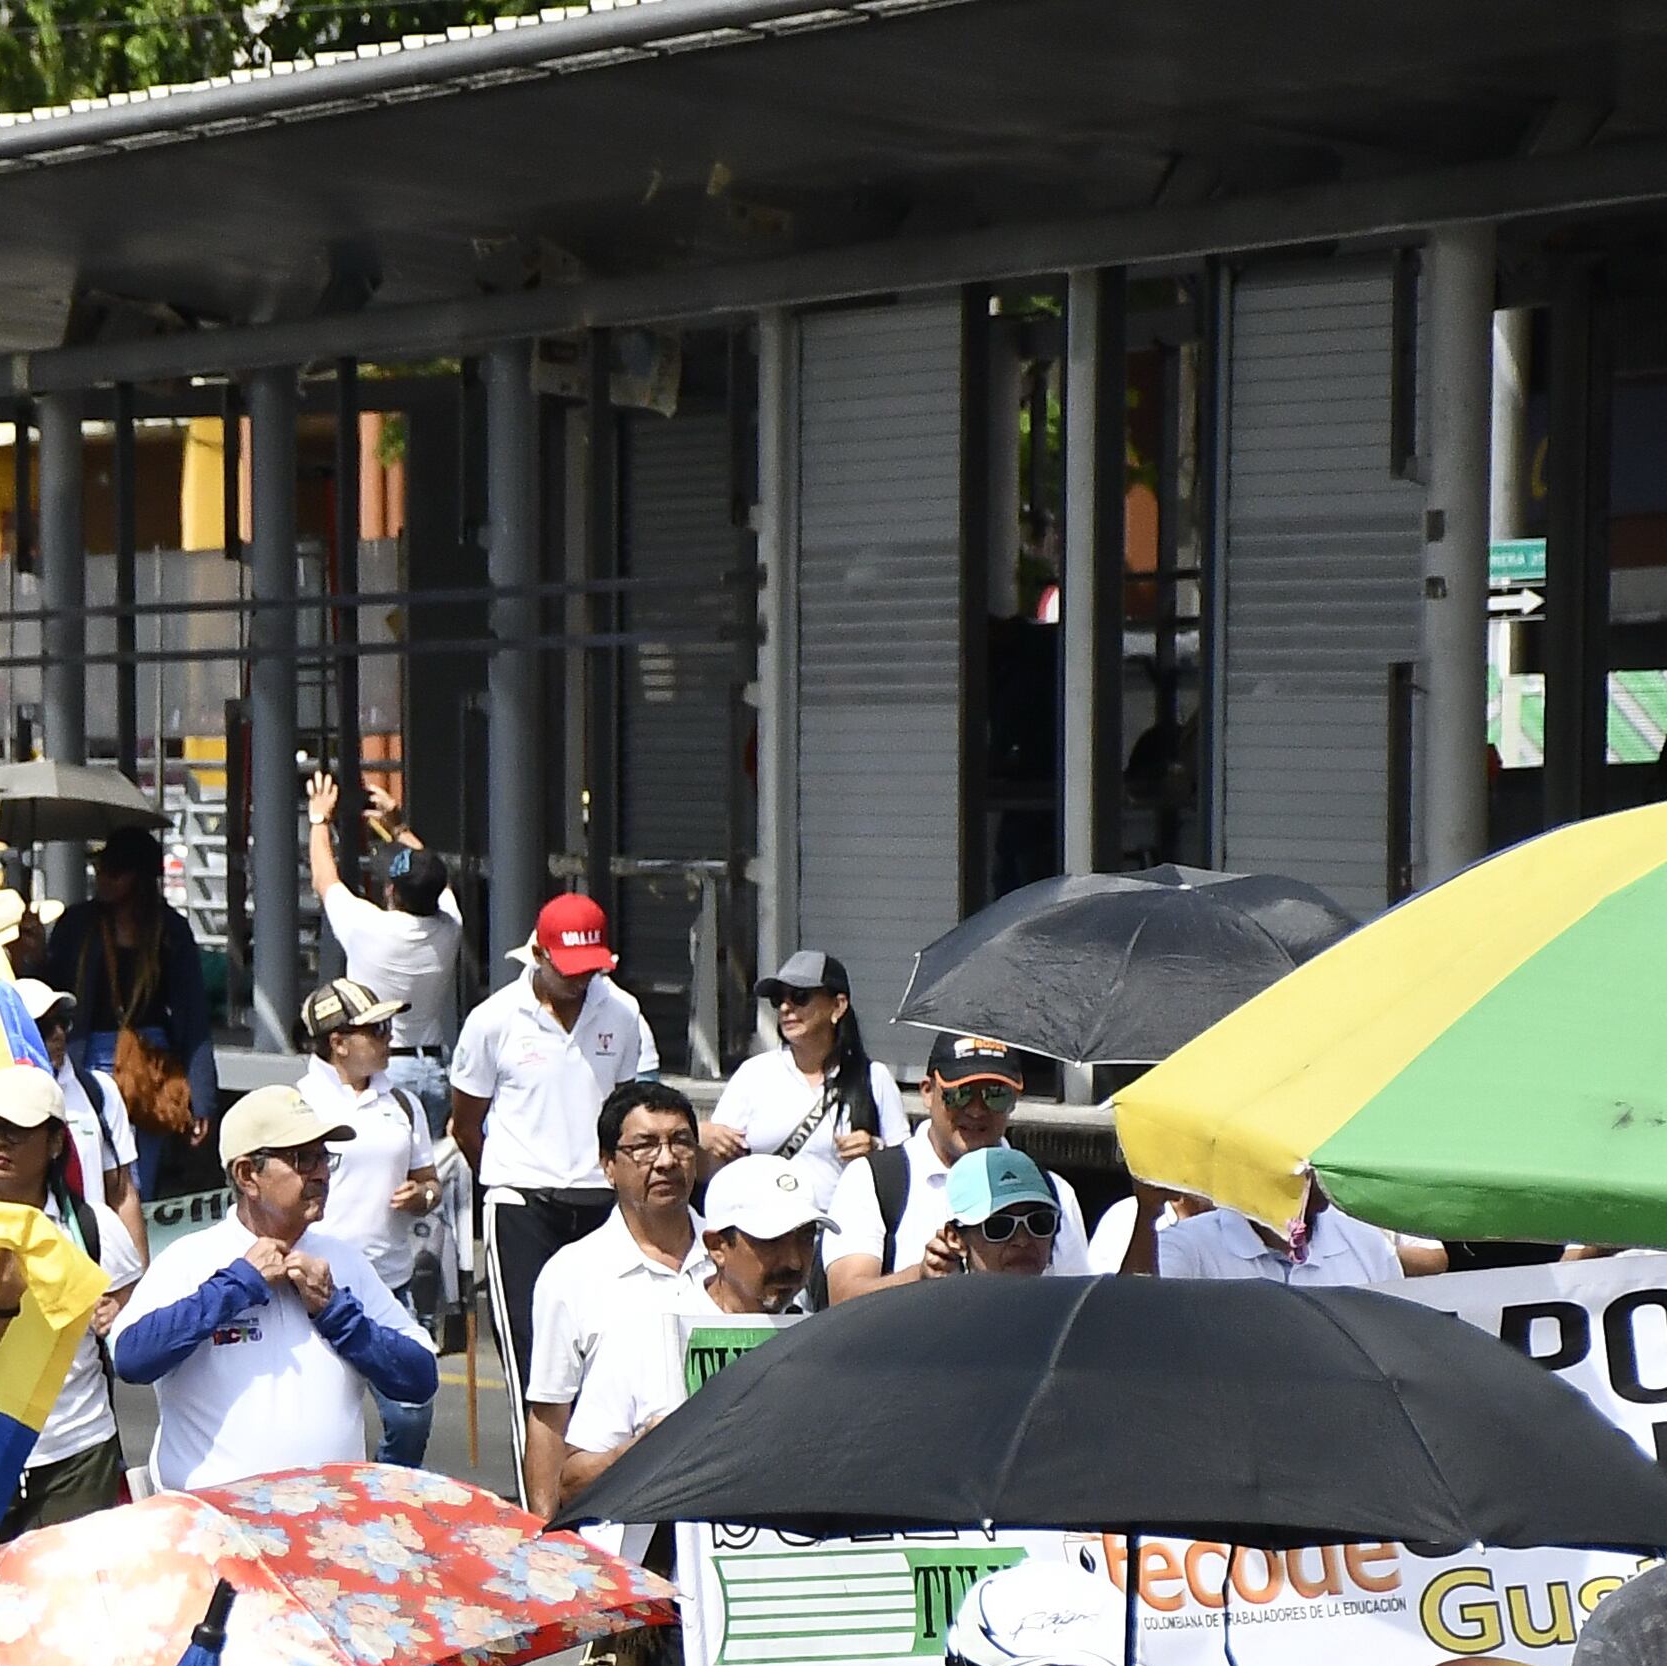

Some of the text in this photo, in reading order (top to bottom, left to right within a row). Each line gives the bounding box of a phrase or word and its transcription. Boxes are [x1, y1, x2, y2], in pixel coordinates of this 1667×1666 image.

[1206, 1616, 1219, 1628] DE
[1310, 1605, 1325, 1619] DE
[1327, 1602, 1342, 1618] LA
[1343, 1595, 1408, 1616] EDUCACIÓN
[1419, 1556, 1664, 1655] Gus
